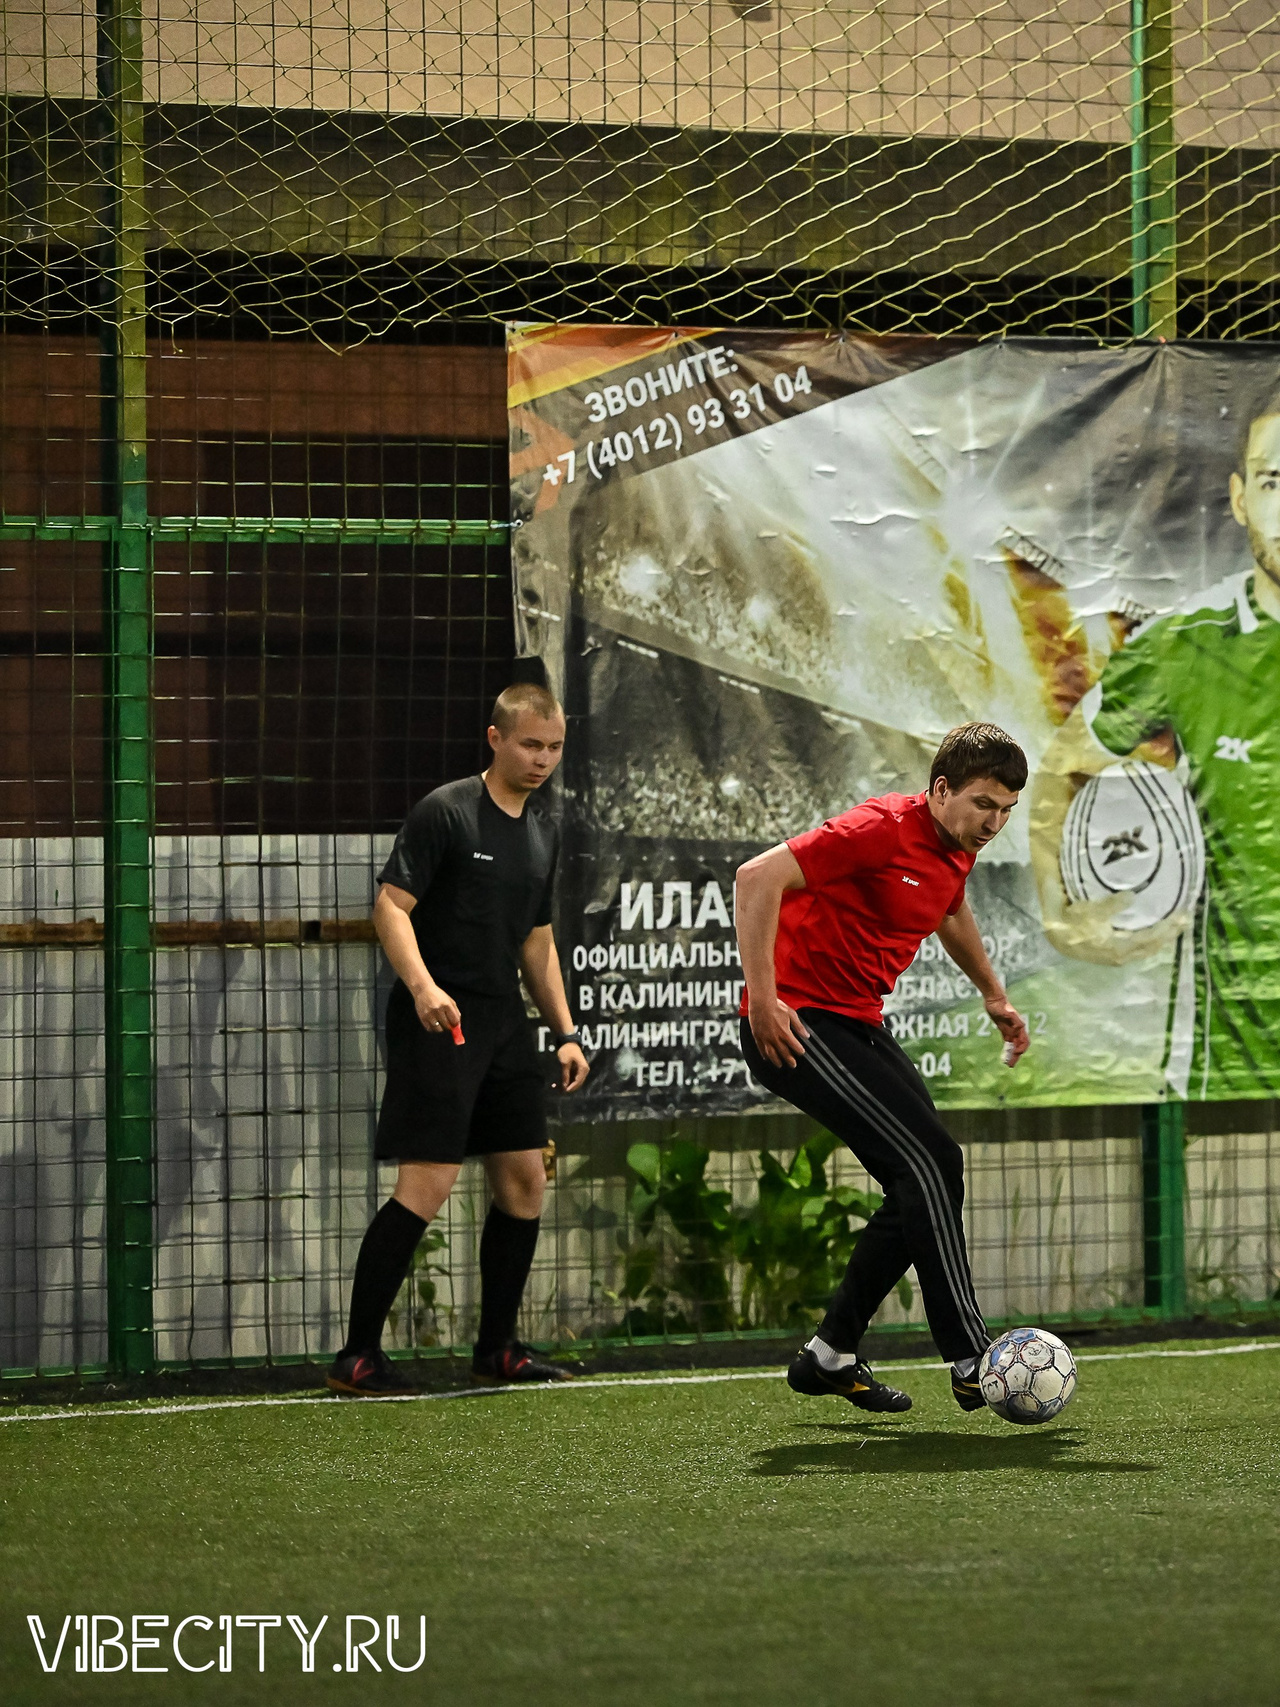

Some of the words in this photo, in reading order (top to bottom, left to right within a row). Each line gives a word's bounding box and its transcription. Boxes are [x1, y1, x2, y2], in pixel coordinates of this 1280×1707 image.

[584, 346, 739, 423] ЗВОНИТЕ:
[543, 450, 576, 486] +7
[587, 412, 683, 479] (4012)
[687, 397, 725, 435] 93
[729, 382, 766, 419] 31
[773, 365, 812, 403] 04
[620, 880, 737, 931] ИЛА
[573, 941, 743, 975] ОФИЦИАЛЬН
[579, 985, 594, 1011] В
[600, 980, 746, 1010] КАЛИНИНГ
[538, 1026, 555, 1052] Г.
[573, 1020, 739, 1051] АЛИНИНГРА
[888, 1013, 970, 1040] ЖНАЯ
